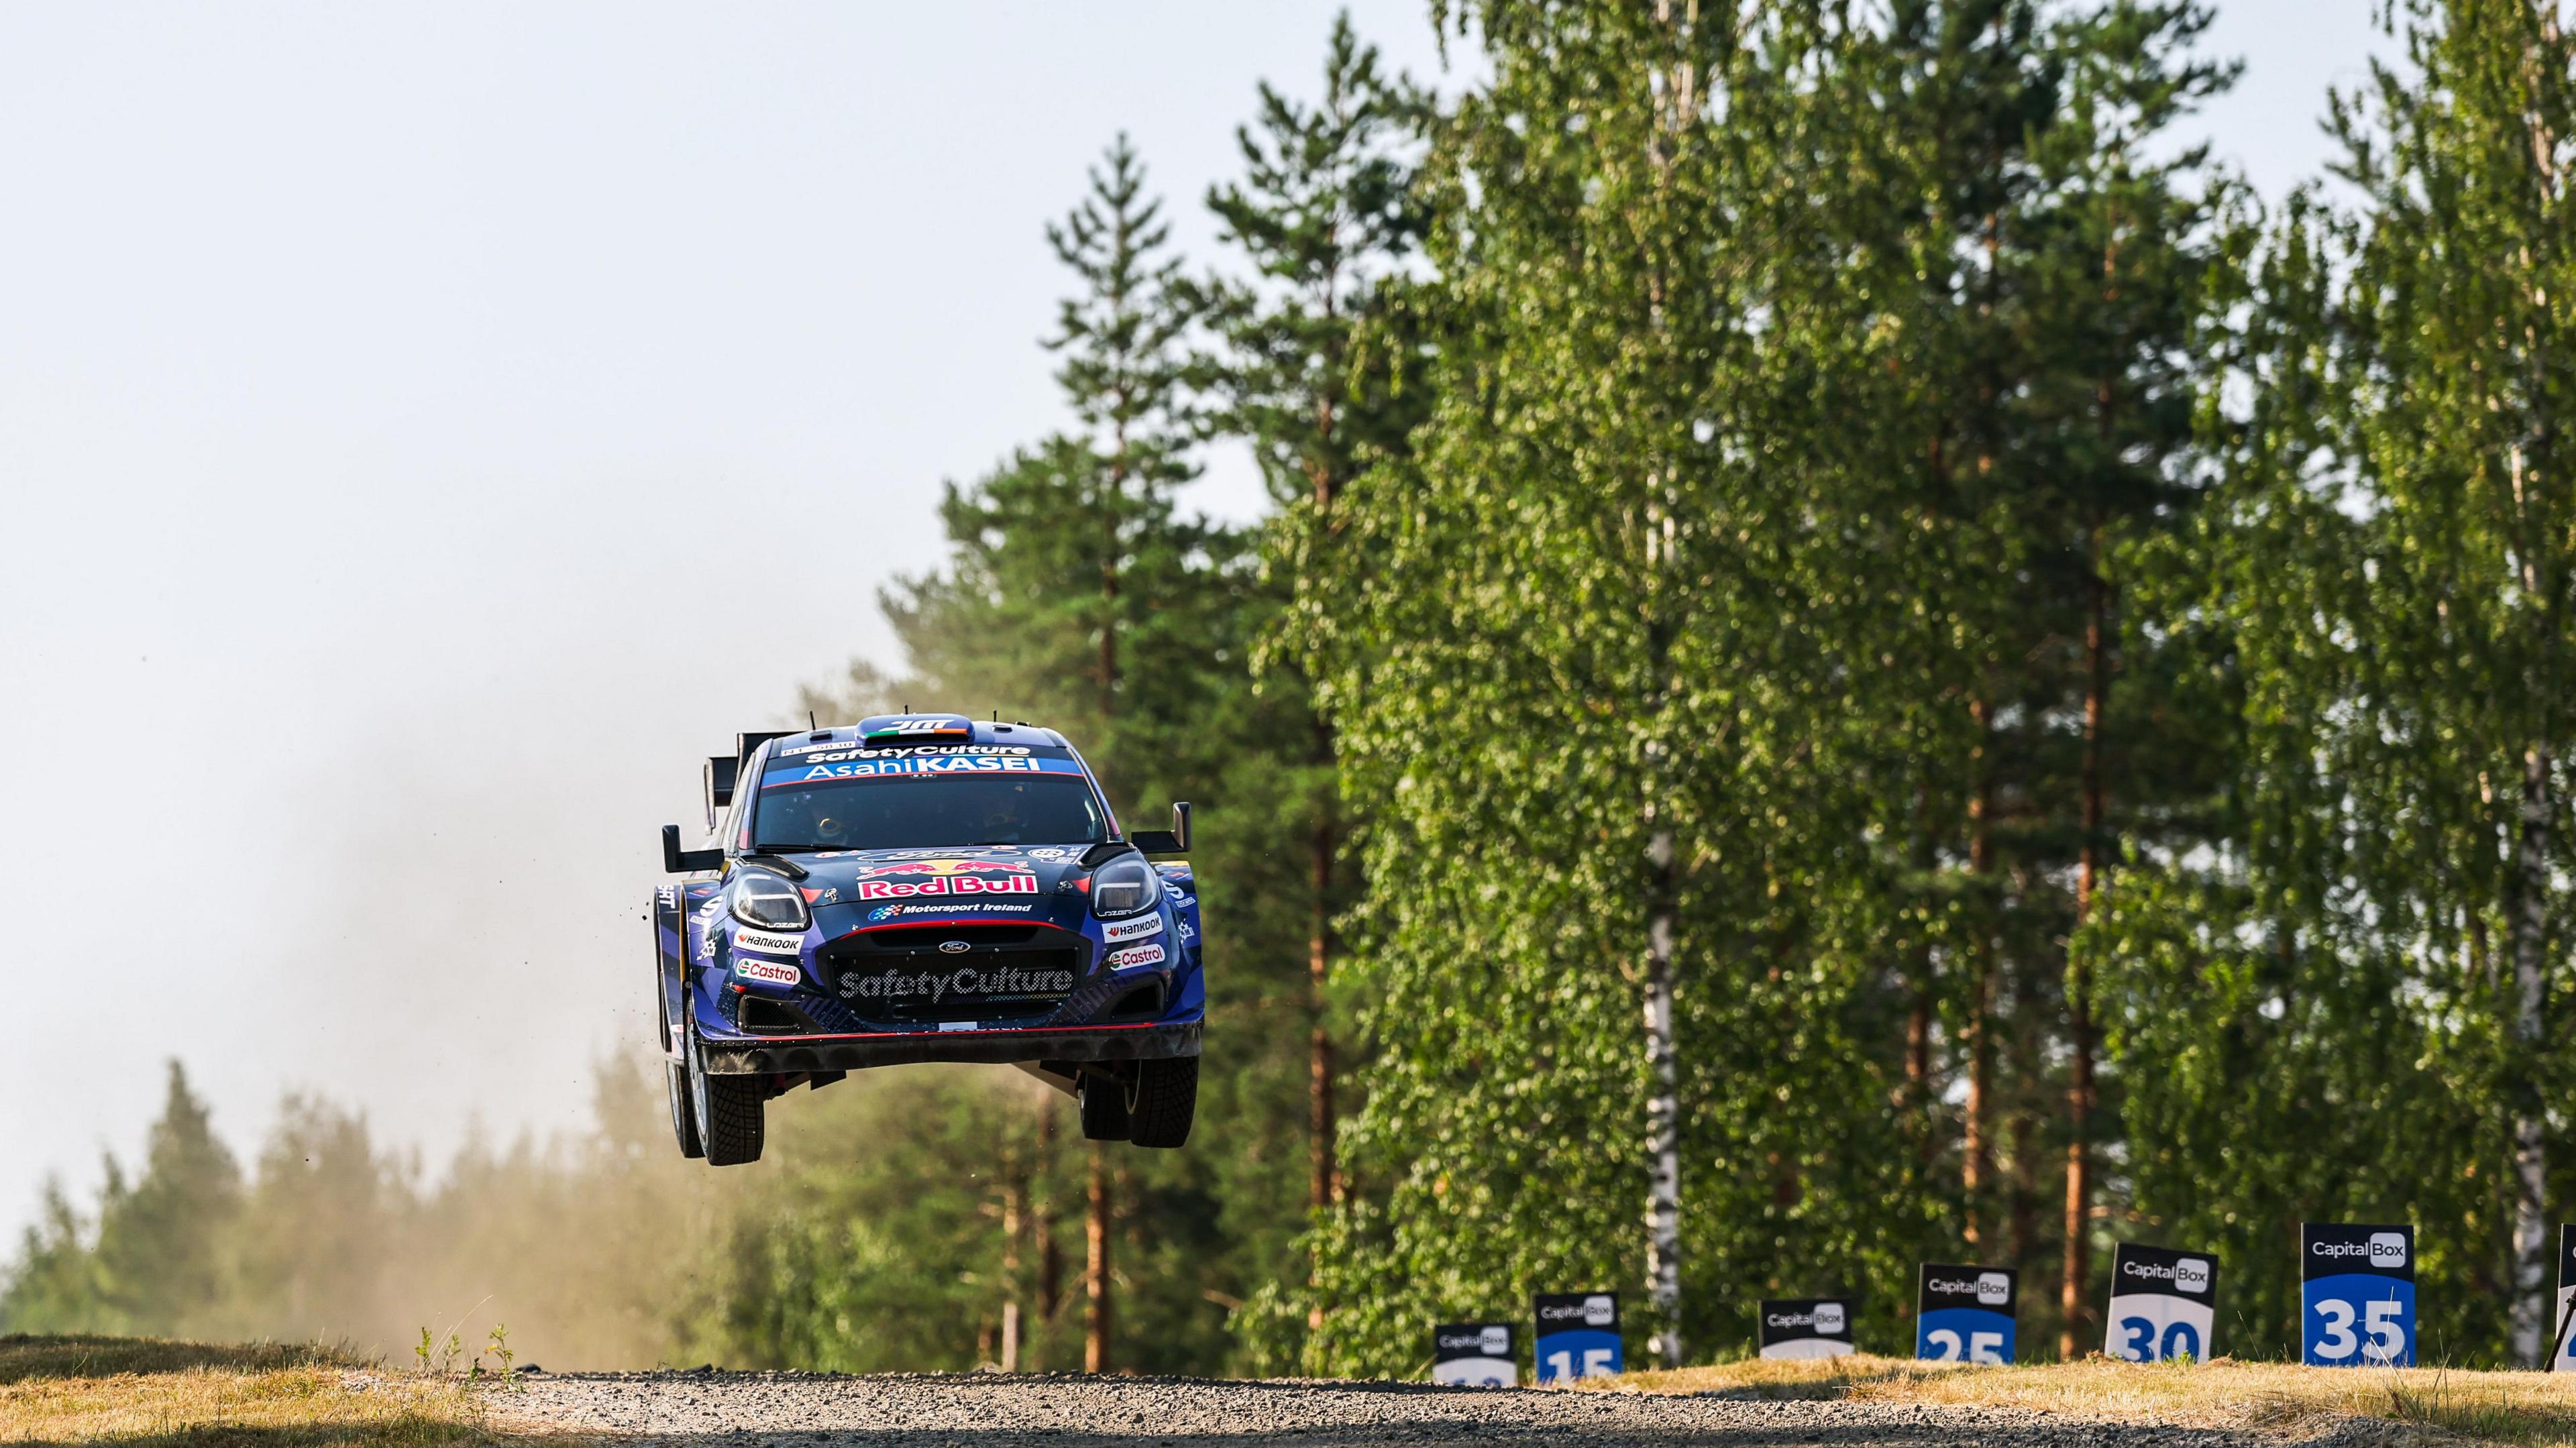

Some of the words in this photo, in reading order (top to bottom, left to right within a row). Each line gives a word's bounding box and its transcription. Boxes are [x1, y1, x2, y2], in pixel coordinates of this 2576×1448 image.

[806, 745, 1031, 763] SafetyCulture
[860, 877, 947, 899] Red
[953, 875, 1036, 893] Bull
[903, 903, 979, 913] Motorsport
[982, 903, 1032, 912] Ireland
[945, 942, 964, 951] Ford
[1122, 946, 1163, 966] Castrol
[751, 963, 796, 982] Castrol
[839, 966, 1073, 1004] SafetyCulture
[2313, 1298, 2406, 1359] 35
[2120, 1316, 2200, 1363] 30
